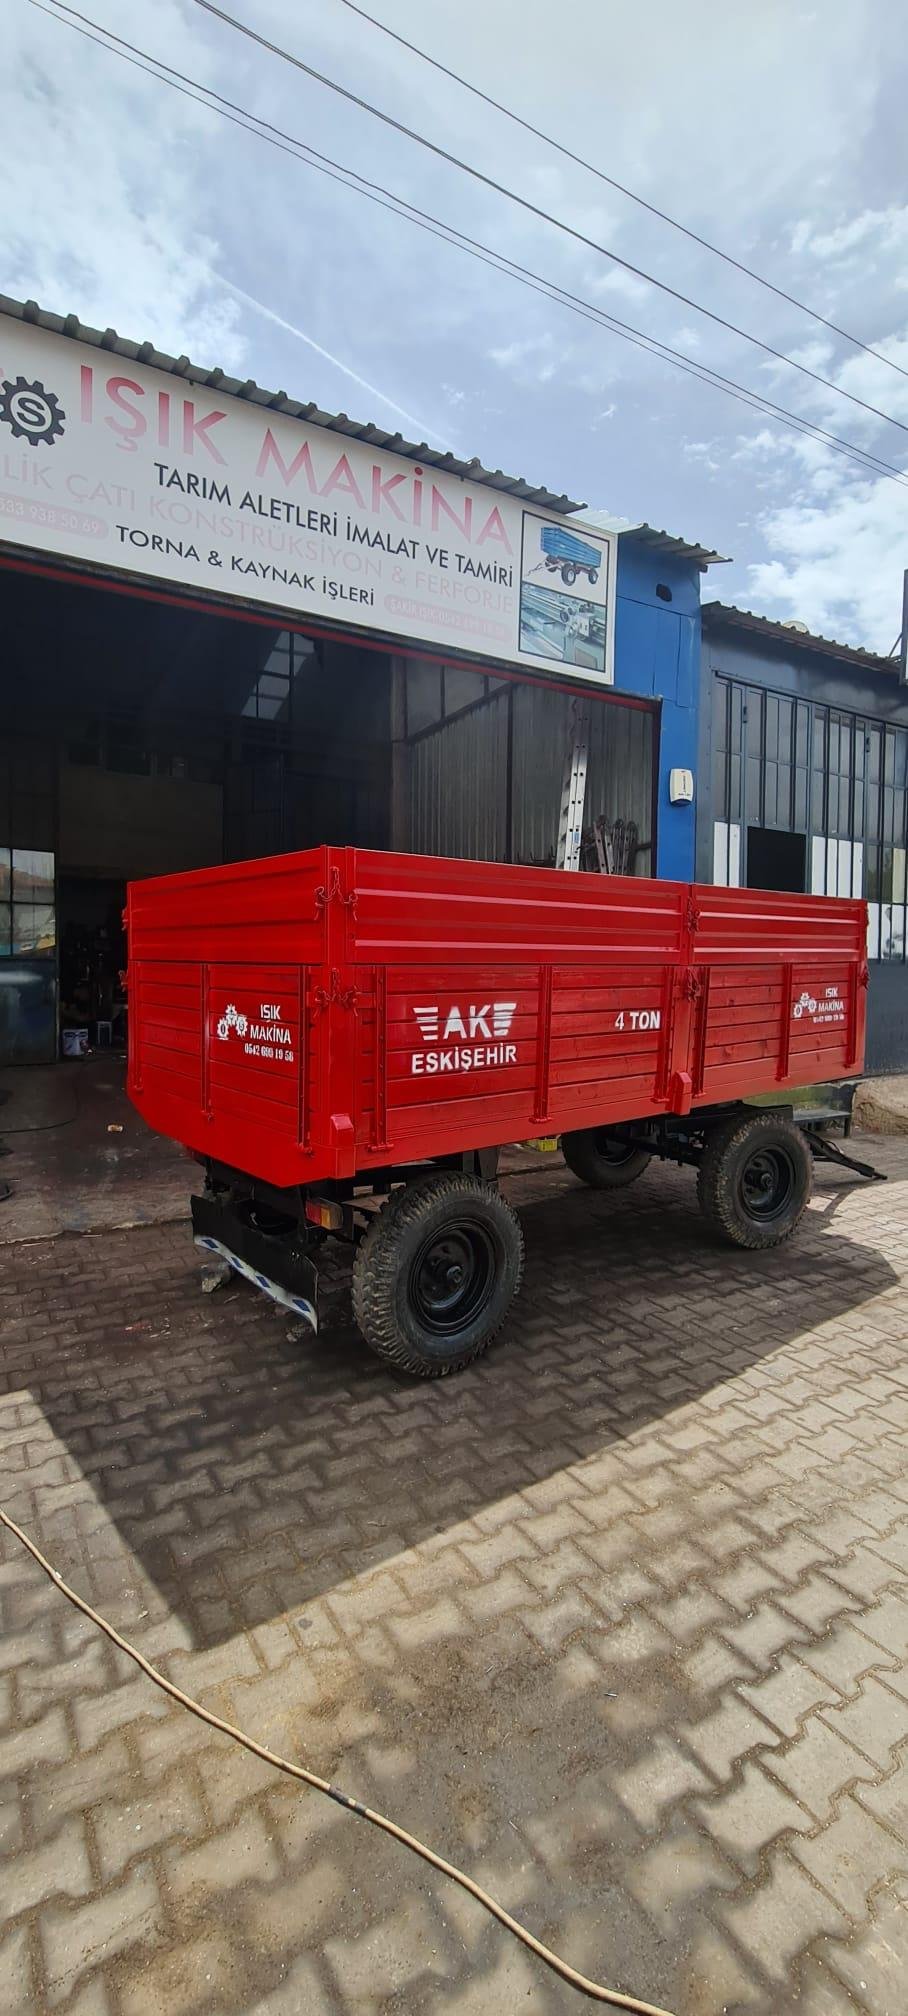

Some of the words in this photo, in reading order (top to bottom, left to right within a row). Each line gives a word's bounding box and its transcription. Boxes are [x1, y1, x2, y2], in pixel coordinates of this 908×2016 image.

[81, 364, 228, 466] IŞIK
[255, 427, 513, 556] MAKİNA
[65, 473, 135, 510] ÇATI
[150, 496, 383, 580] KONSTRÜKSİYON
[116, 525, 200, 562] TORNA
[207, 551, 223, 567] &
[231, 555, 315, 591] KAYNAK
[322, 575, 374, 606] İŞLERİ
[154, 462, 231, 506] TARIM
[239, 491, 338, 537] ALETLERİ
[346, 516, 420, 559] İMALAT
[426, 545, 449, 569] VE
[455, 554, 513, 588] TAMİRİ
[250, 1023, 292, 1045] MAKİNA
[411, 1042, 517, 1074] ESKİŞEHİR
[614, 1011, 625, 1031] 4
[629, 1010, 661, 1031] TON
